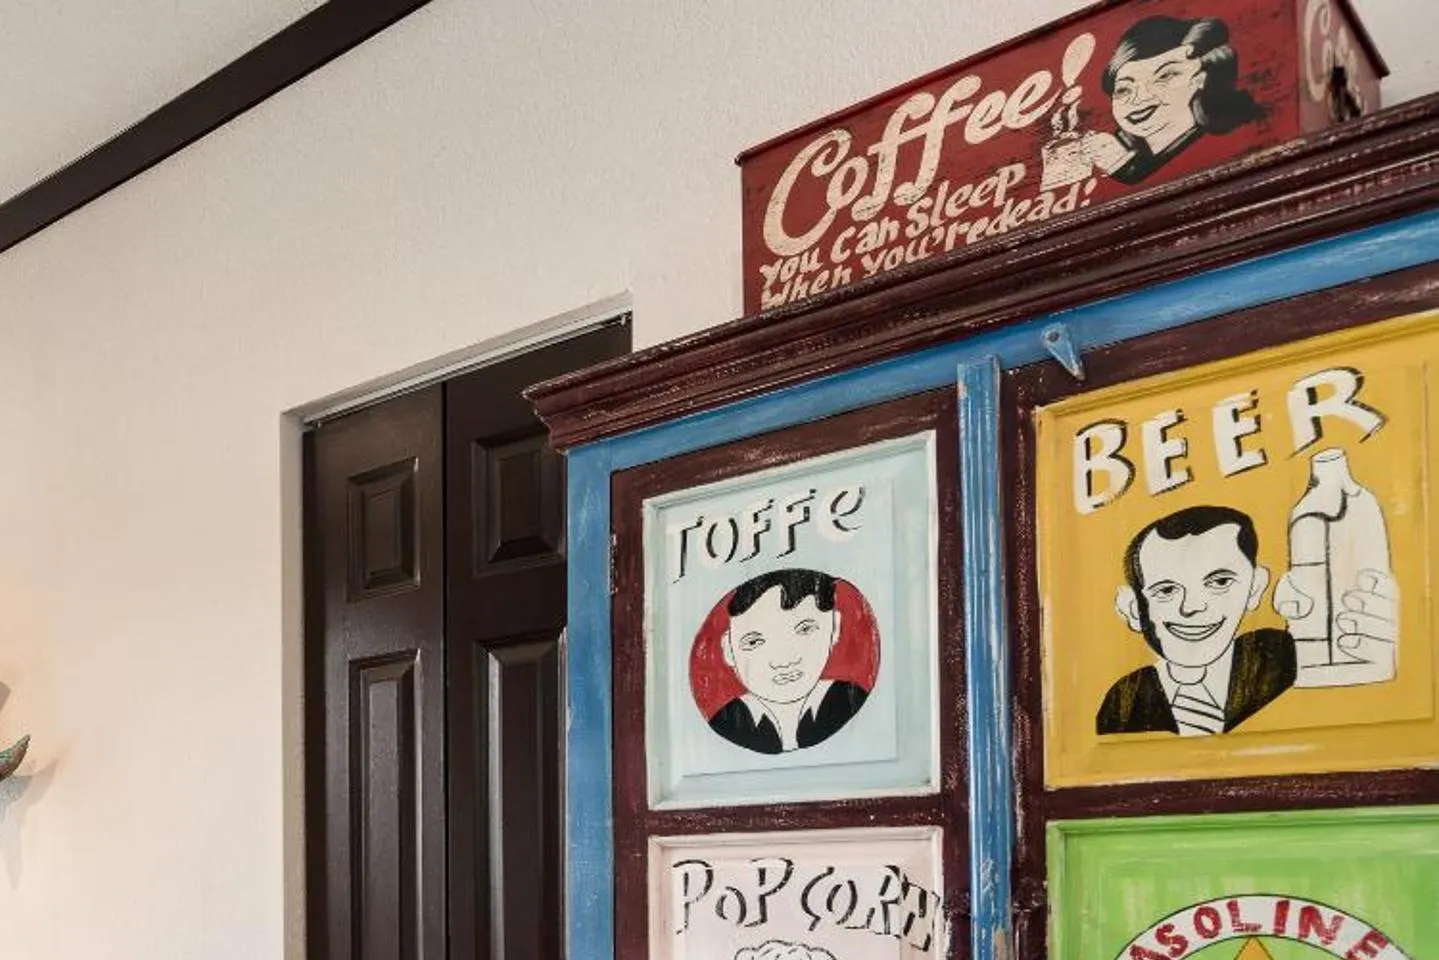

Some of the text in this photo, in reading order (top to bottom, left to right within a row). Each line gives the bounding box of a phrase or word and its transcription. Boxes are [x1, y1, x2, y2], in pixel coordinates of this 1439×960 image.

[763, 32, 1096, 256] Coffee!
[830, 217, 900, 264] can
[1073, 366, 1389, 515] BEER
